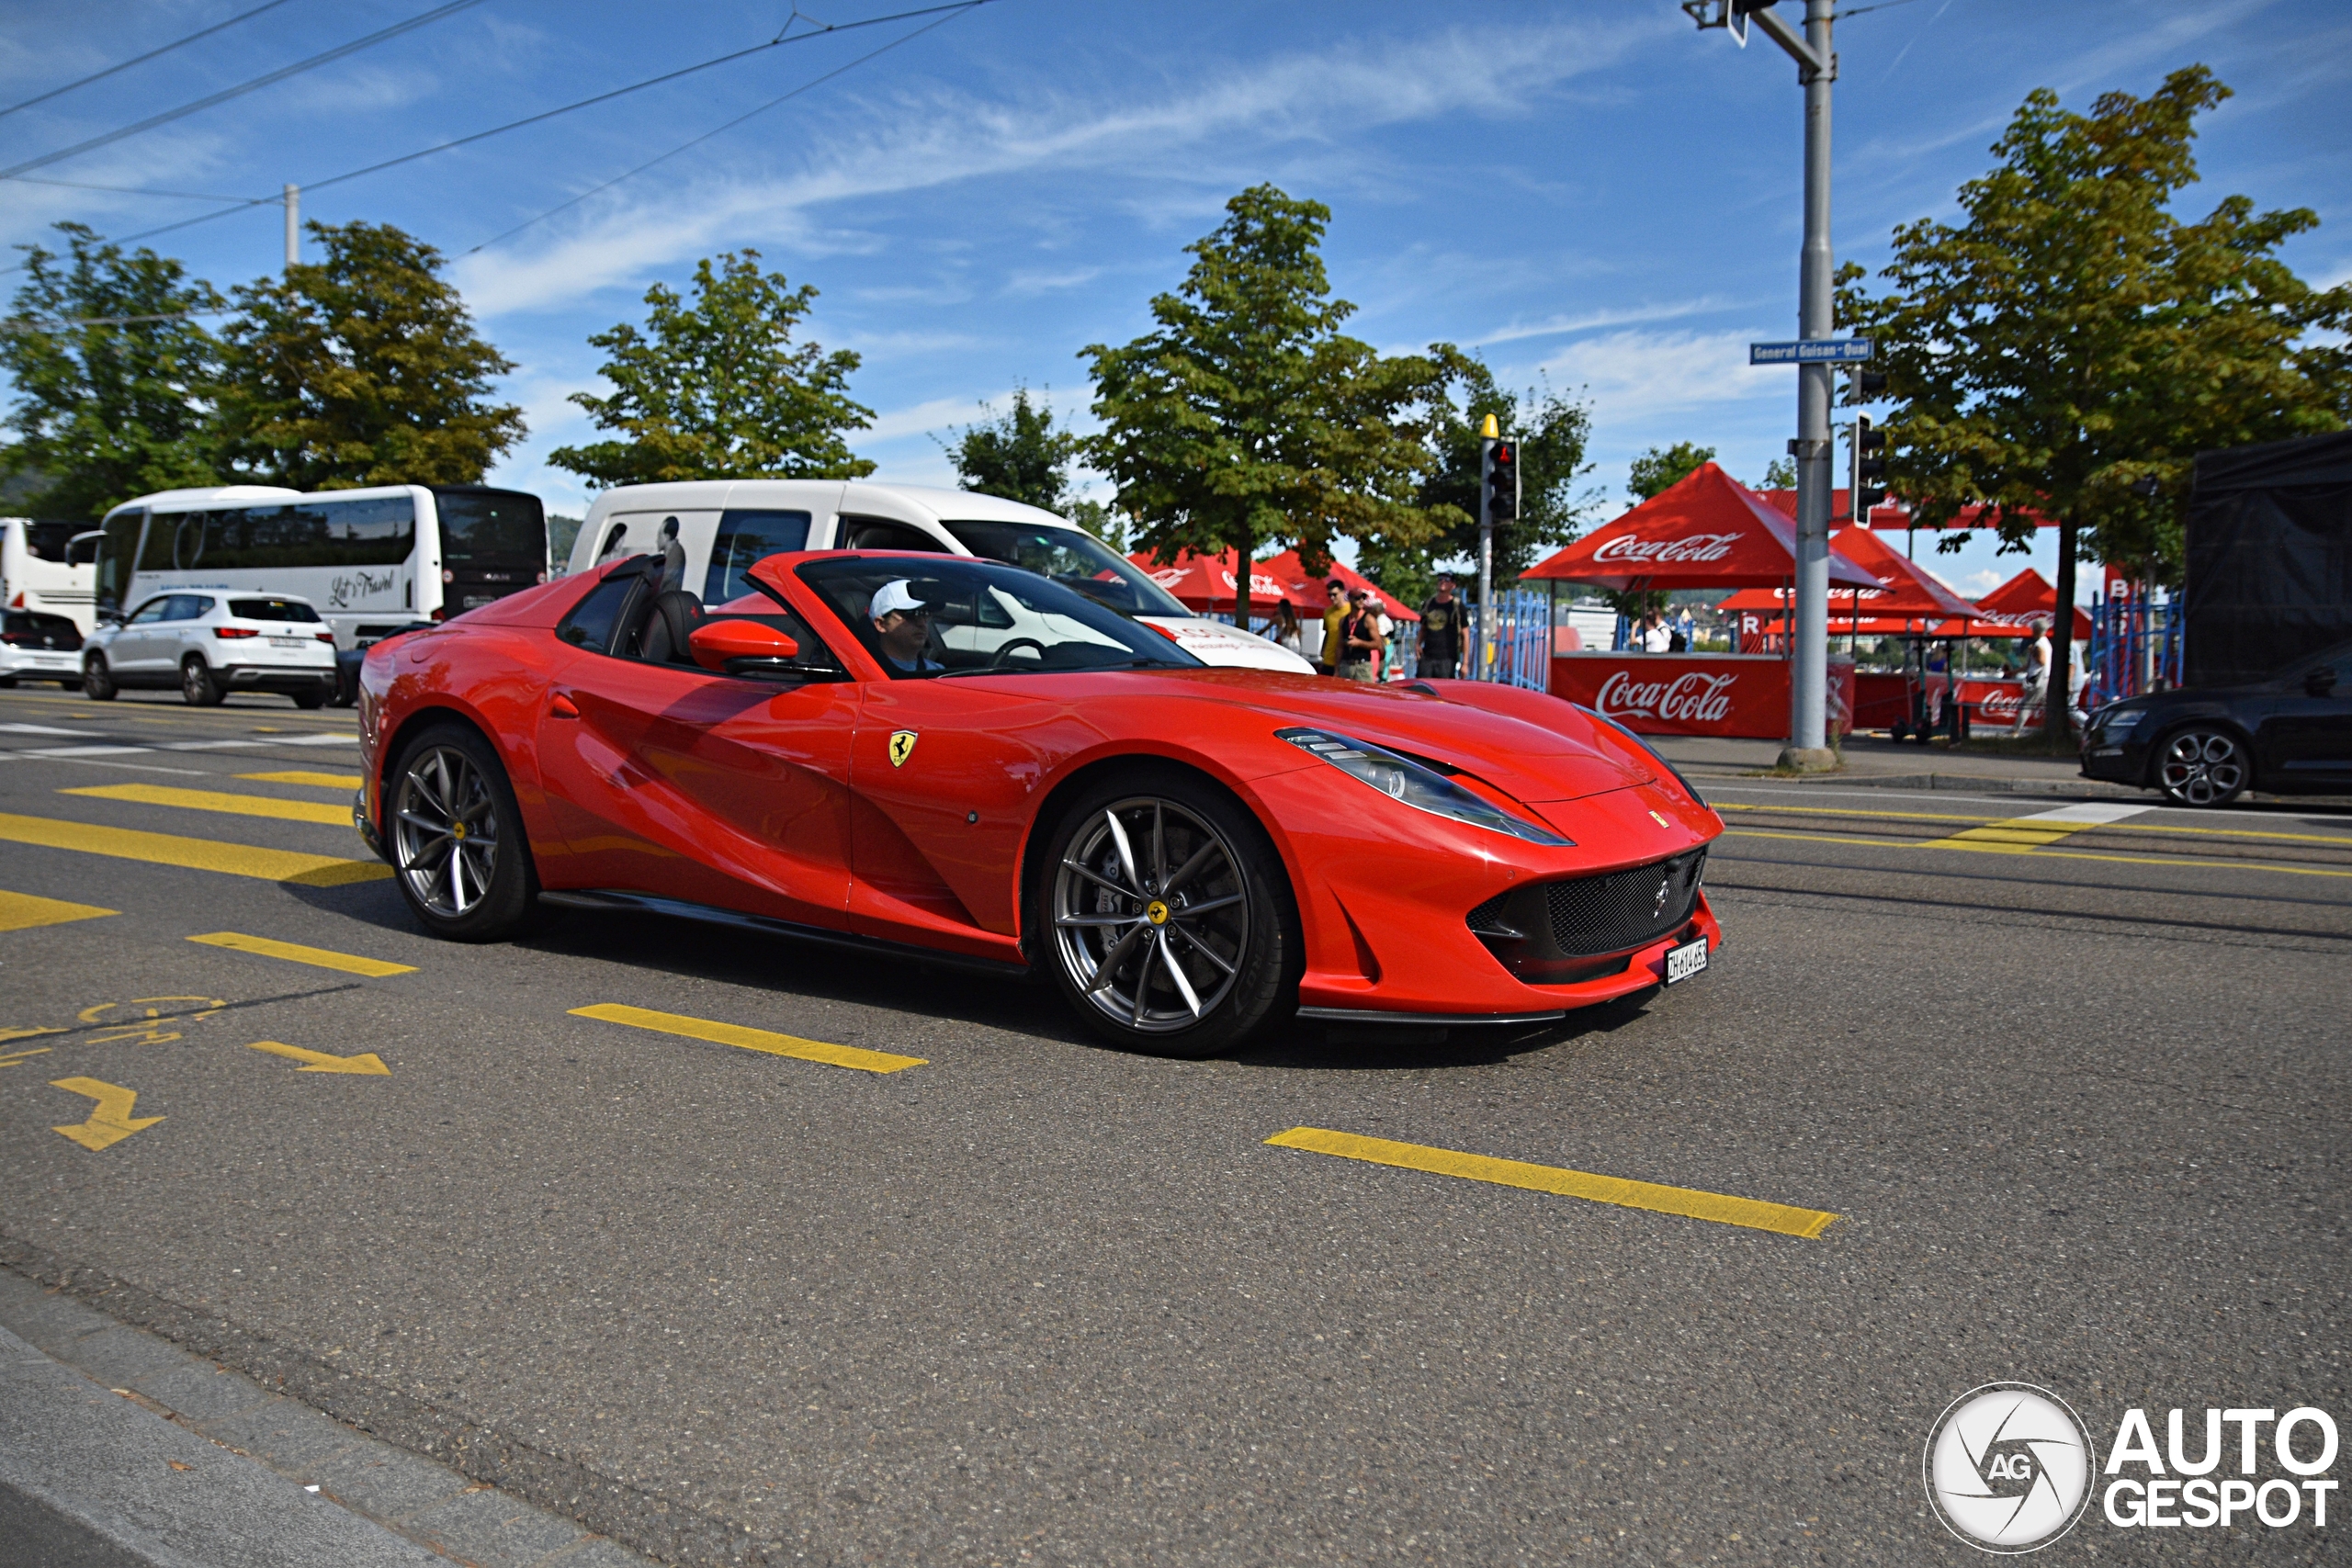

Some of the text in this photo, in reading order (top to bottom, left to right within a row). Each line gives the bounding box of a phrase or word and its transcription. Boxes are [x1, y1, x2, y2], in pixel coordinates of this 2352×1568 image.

[1754, 345, 1796, 360] General
[1592, 531, 1747, 562] Coca-Cola
[356, 569, 393, 599] Travel
[1595, 670, 1739, 722] Coca-Cola
